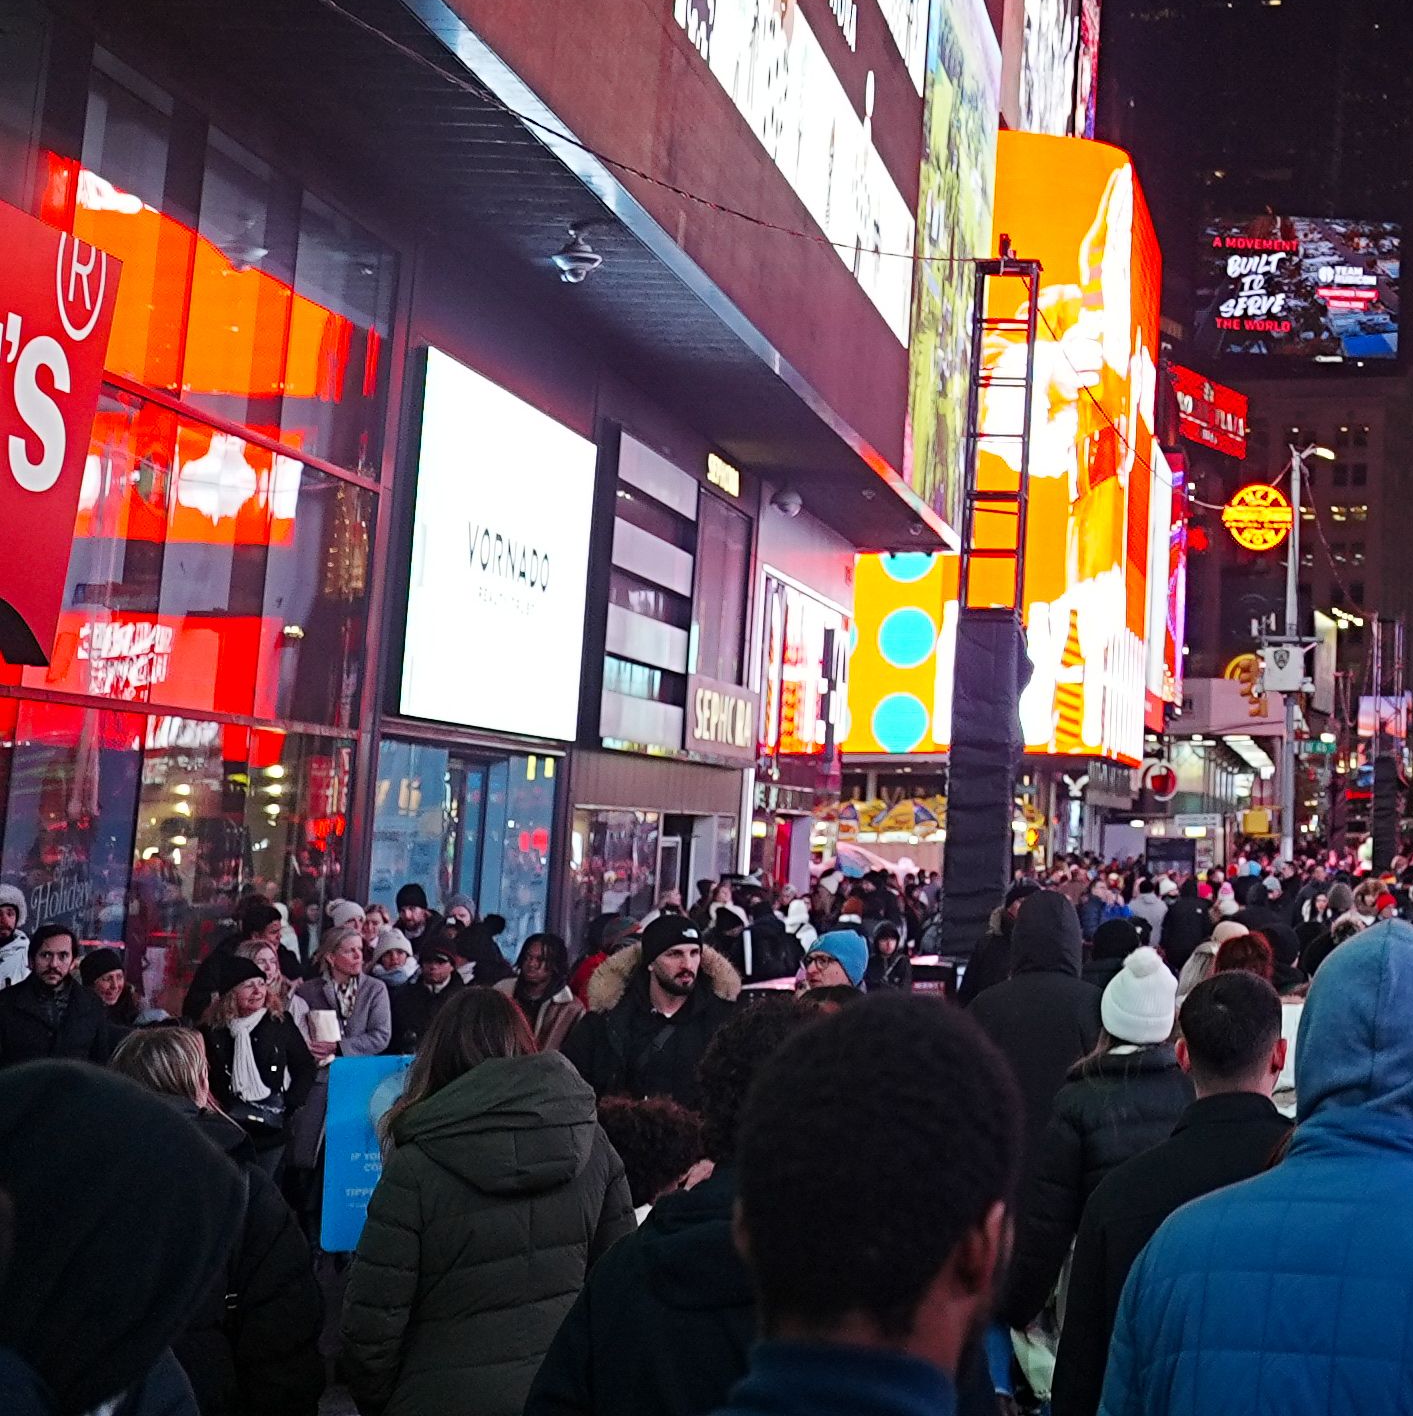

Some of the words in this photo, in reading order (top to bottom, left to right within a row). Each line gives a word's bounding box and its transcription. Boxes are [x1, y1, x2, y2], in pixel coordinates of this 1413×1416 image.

[1212, 236, 1222, 248] A
[1225, 237, 1299, 251] MOVEMENT
[1226, 252, 1287, 278] BUILT
[1240, 274, 1265, 292] TO
[1219, 293, 1287, 318] SERVE
[1215, 317, 1241, 331] THE
[1244, 319, 1292, 333] WORLD
[0, 311, 71, 493] 'S
[468, 521, 549, 592] VORNADO
